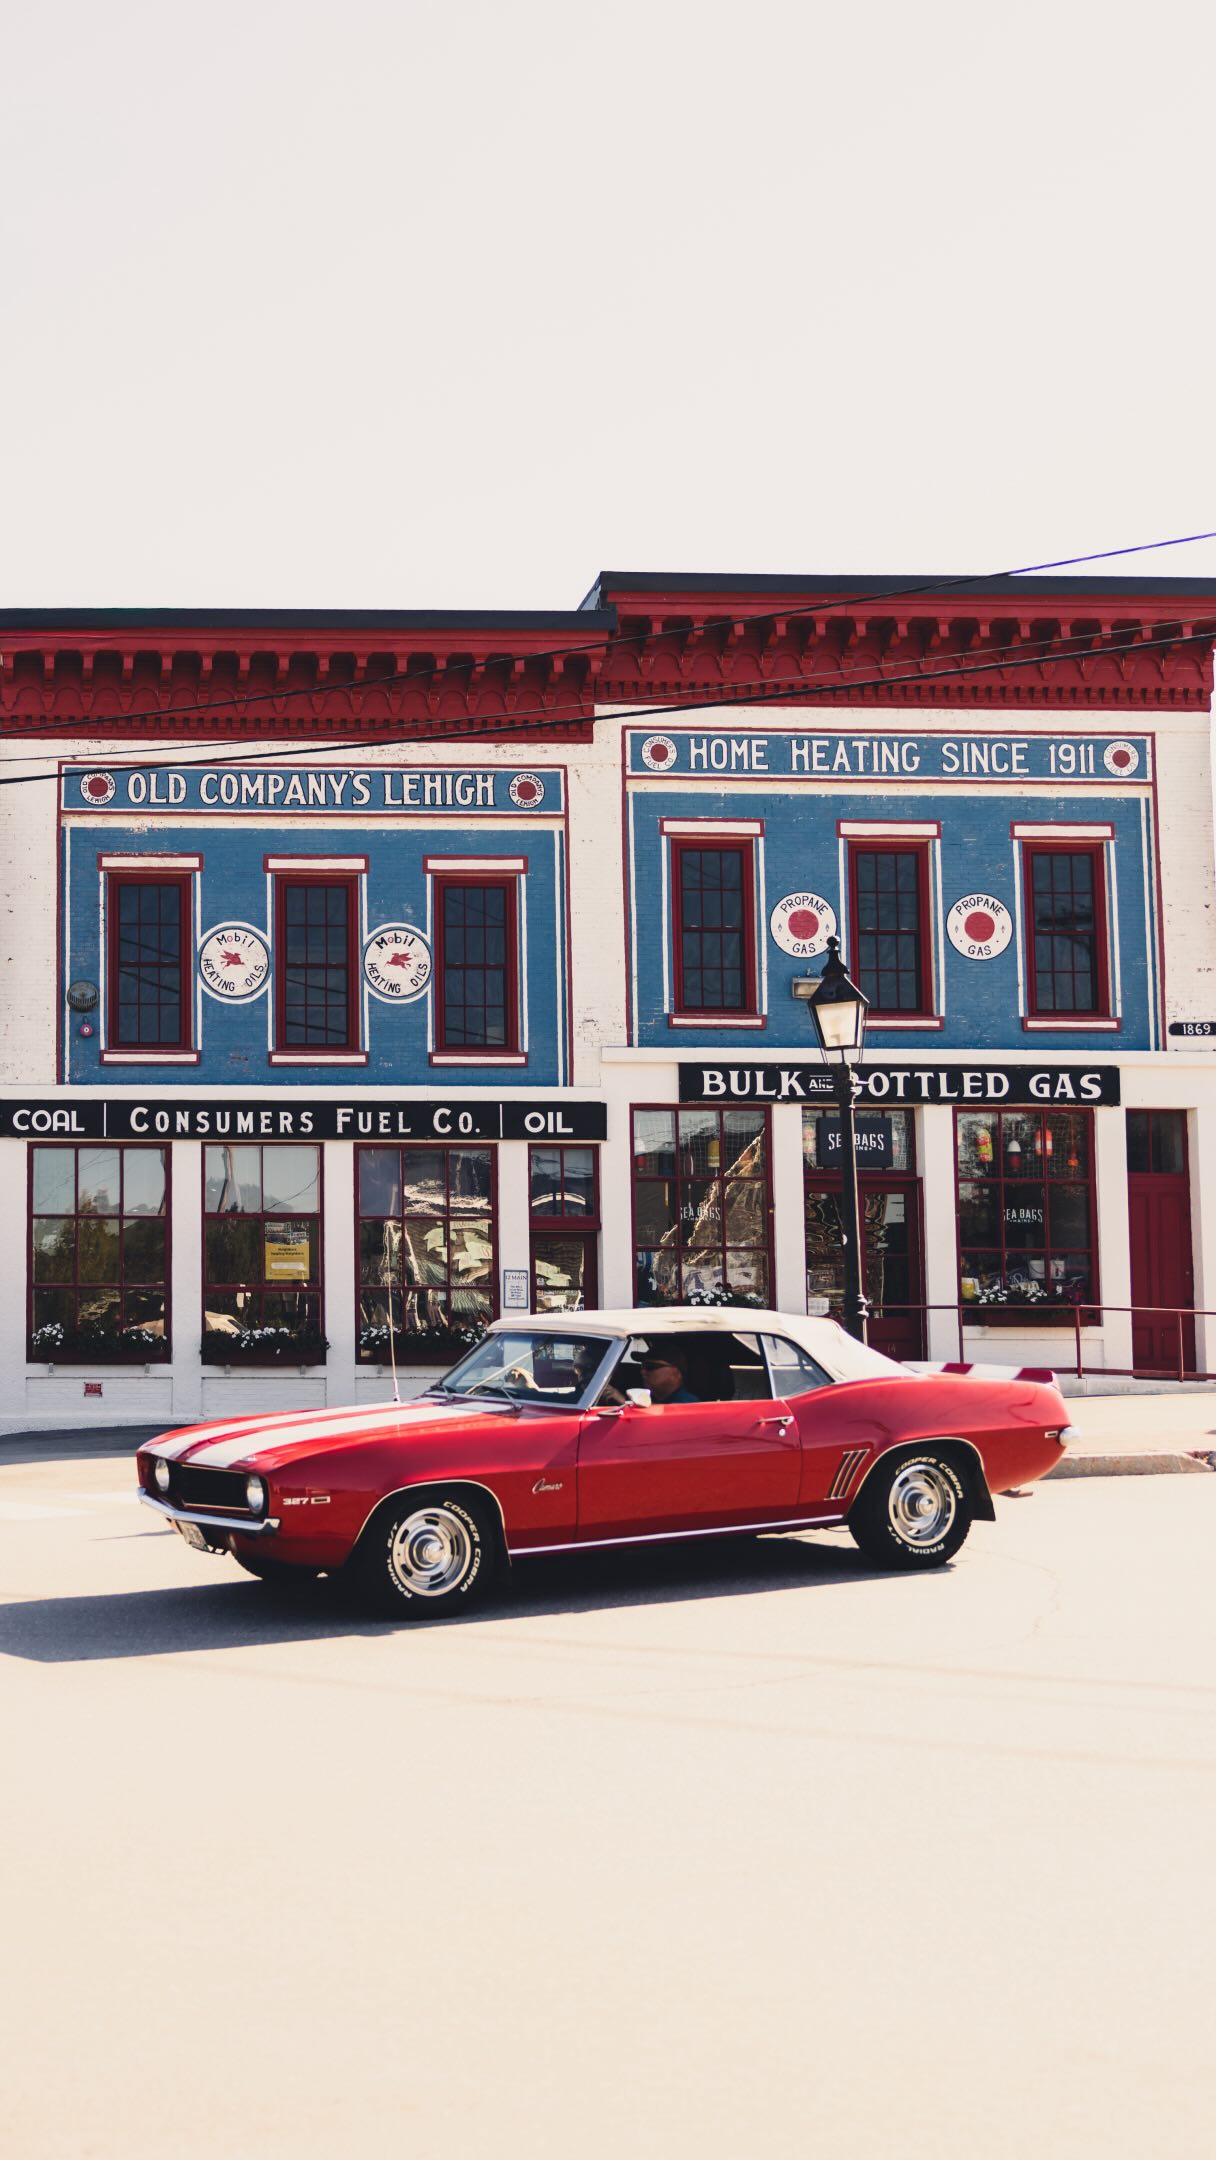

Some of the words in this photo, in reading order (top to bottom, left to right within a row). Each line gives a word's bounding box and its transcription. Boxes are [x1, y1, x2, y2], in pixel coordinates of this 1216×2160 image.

[644, 756, 661, 769] FUEL
[690, 738, 769, 769] HOME
[791, 739, 920, 772] HEATING
[942, 742, 1030, 773] SINCE
[1049, 743, 1096, 774] 1911
[1106, 762, 1122, 775] FUEL
[127, 772, 187, 804] OLD
[199, 770, 371, 806] COMPANY'S
[383, 774, 496, 806] LEHIGH
[87, 795, 110, 804] LEHIGH
[516, 798, 538, 807] LEHIGH
[780, 895, 829, 916] PROPANE
[955, 896, 1004, 916] PROPANE
[216, 932, 255, 948] Mobil
[375, 932, 415, 949] Mobil
[792, 943, 816, 954] GAS
[968, 945, 992, 956] GAS
[203, 958, 235, 992] HEATING
[245, 965, 264, 987] OILS
[368, 963, 401, 993] HEATING
[410, 963, 428, 987] OILS
[1182, 1023, 1211, 1035] 1869
[702, 1070, 807, 1097] BULK
[1029, 1073, 1102, 1099] GAS
[12, 1109, 85, 1132] COAL
[130, 1107, 314, 1133] CONSUMERS
[336, 1108, 411, 1133] FUEL
[524, 1111, 573, 1133] OIL
[828, 1133, 842, 1151] SE
[853, 1133, 884, 1151] BAGS
[1019, 1208, 1043, 1223] BAGS
[895, 1456, 936, 1476] COOPER
[939, 1462, 964, 1499] COBRA
[282, 1497, 309, 1505] 327
[443, 1501, 480, 1542] COOPER
[906, 1542, 945, 1555] RADIAL
[387, 1556, 412, 1599] RADIAL
[460, 1547, 481, 1592] COBRA
